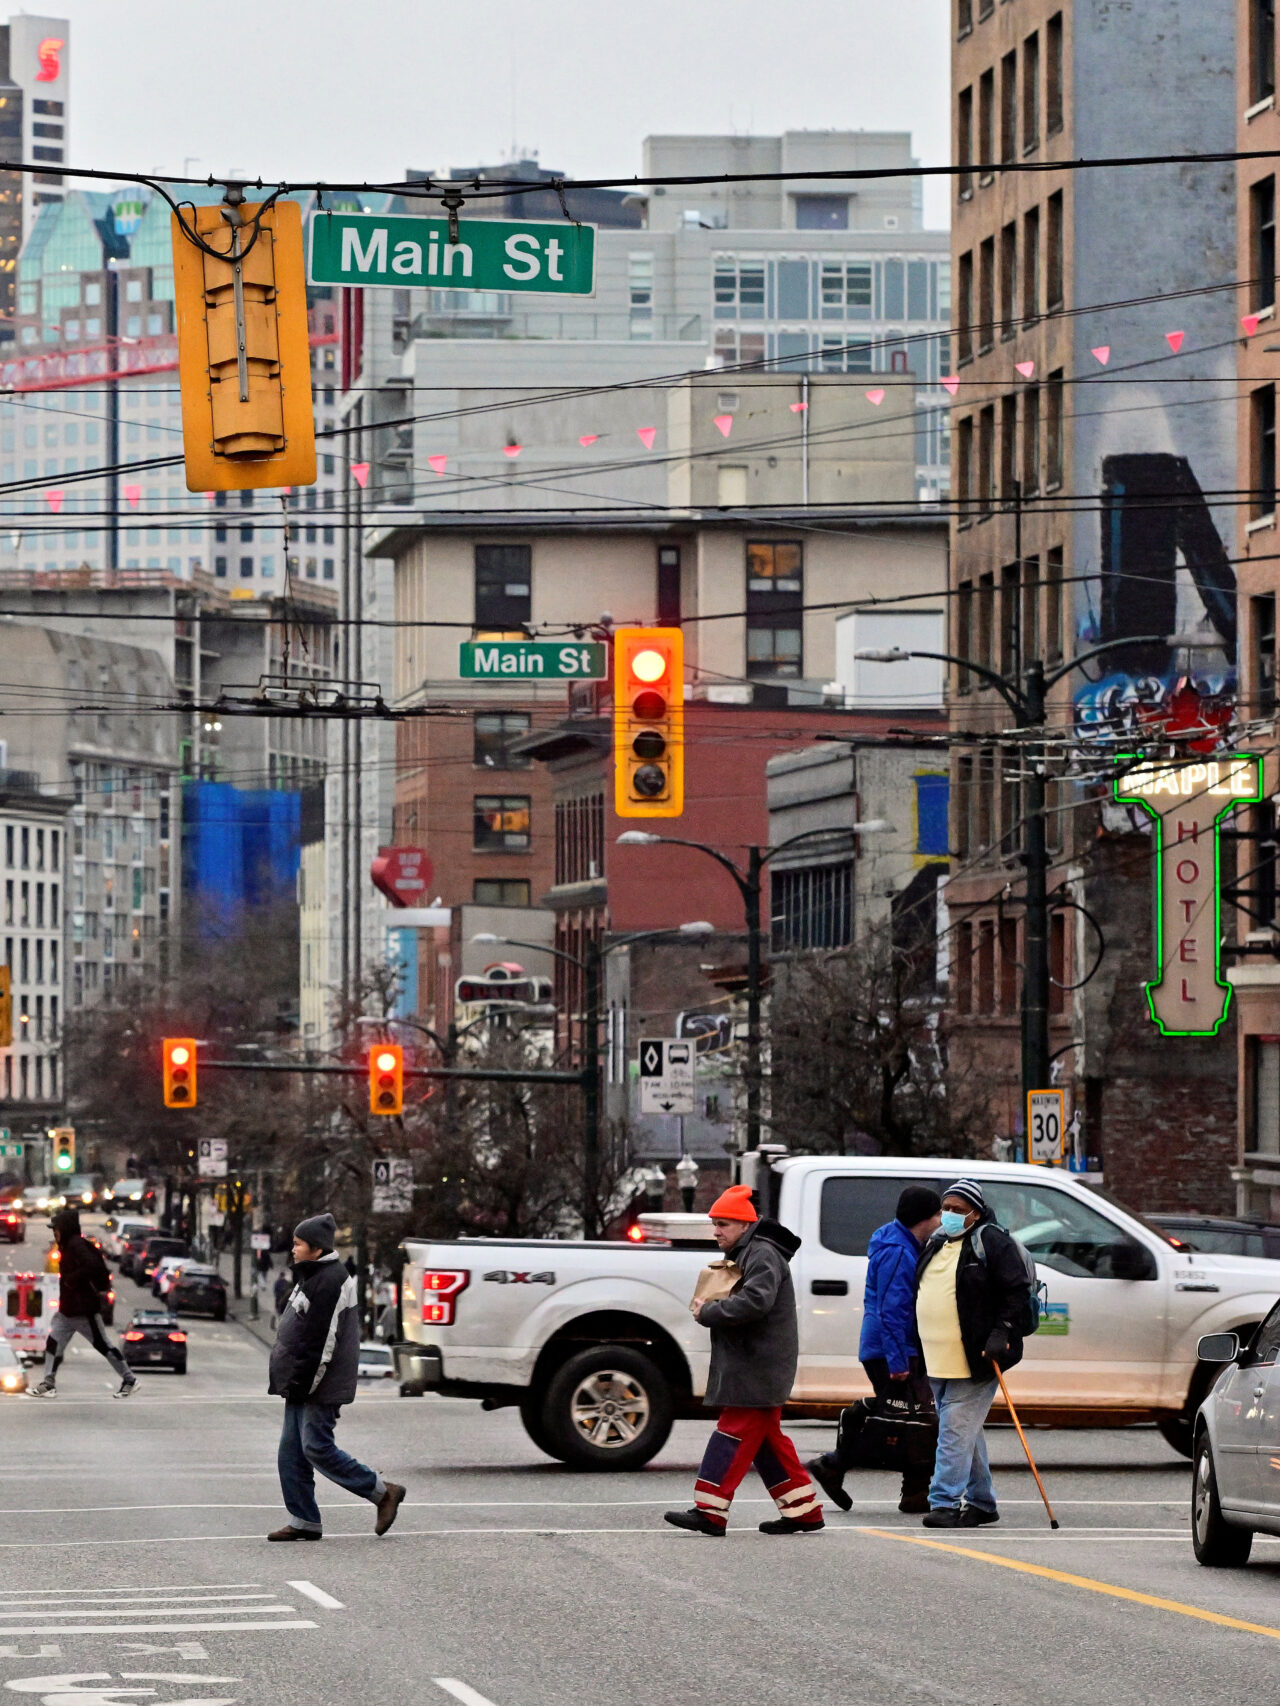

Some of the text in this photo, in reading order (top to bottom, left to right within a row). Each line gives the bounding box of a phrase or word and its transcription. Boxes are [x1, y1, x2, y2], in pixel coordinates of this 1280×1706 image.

[340, 227, 564, 282] Main St
[474, 647, 591, 674] Main St
[1123, 761, 1254, 795] MAPLE
[1176, 820, 1200, 1003] HOTEL
[1033, 1112, 1059, 1143] 30
